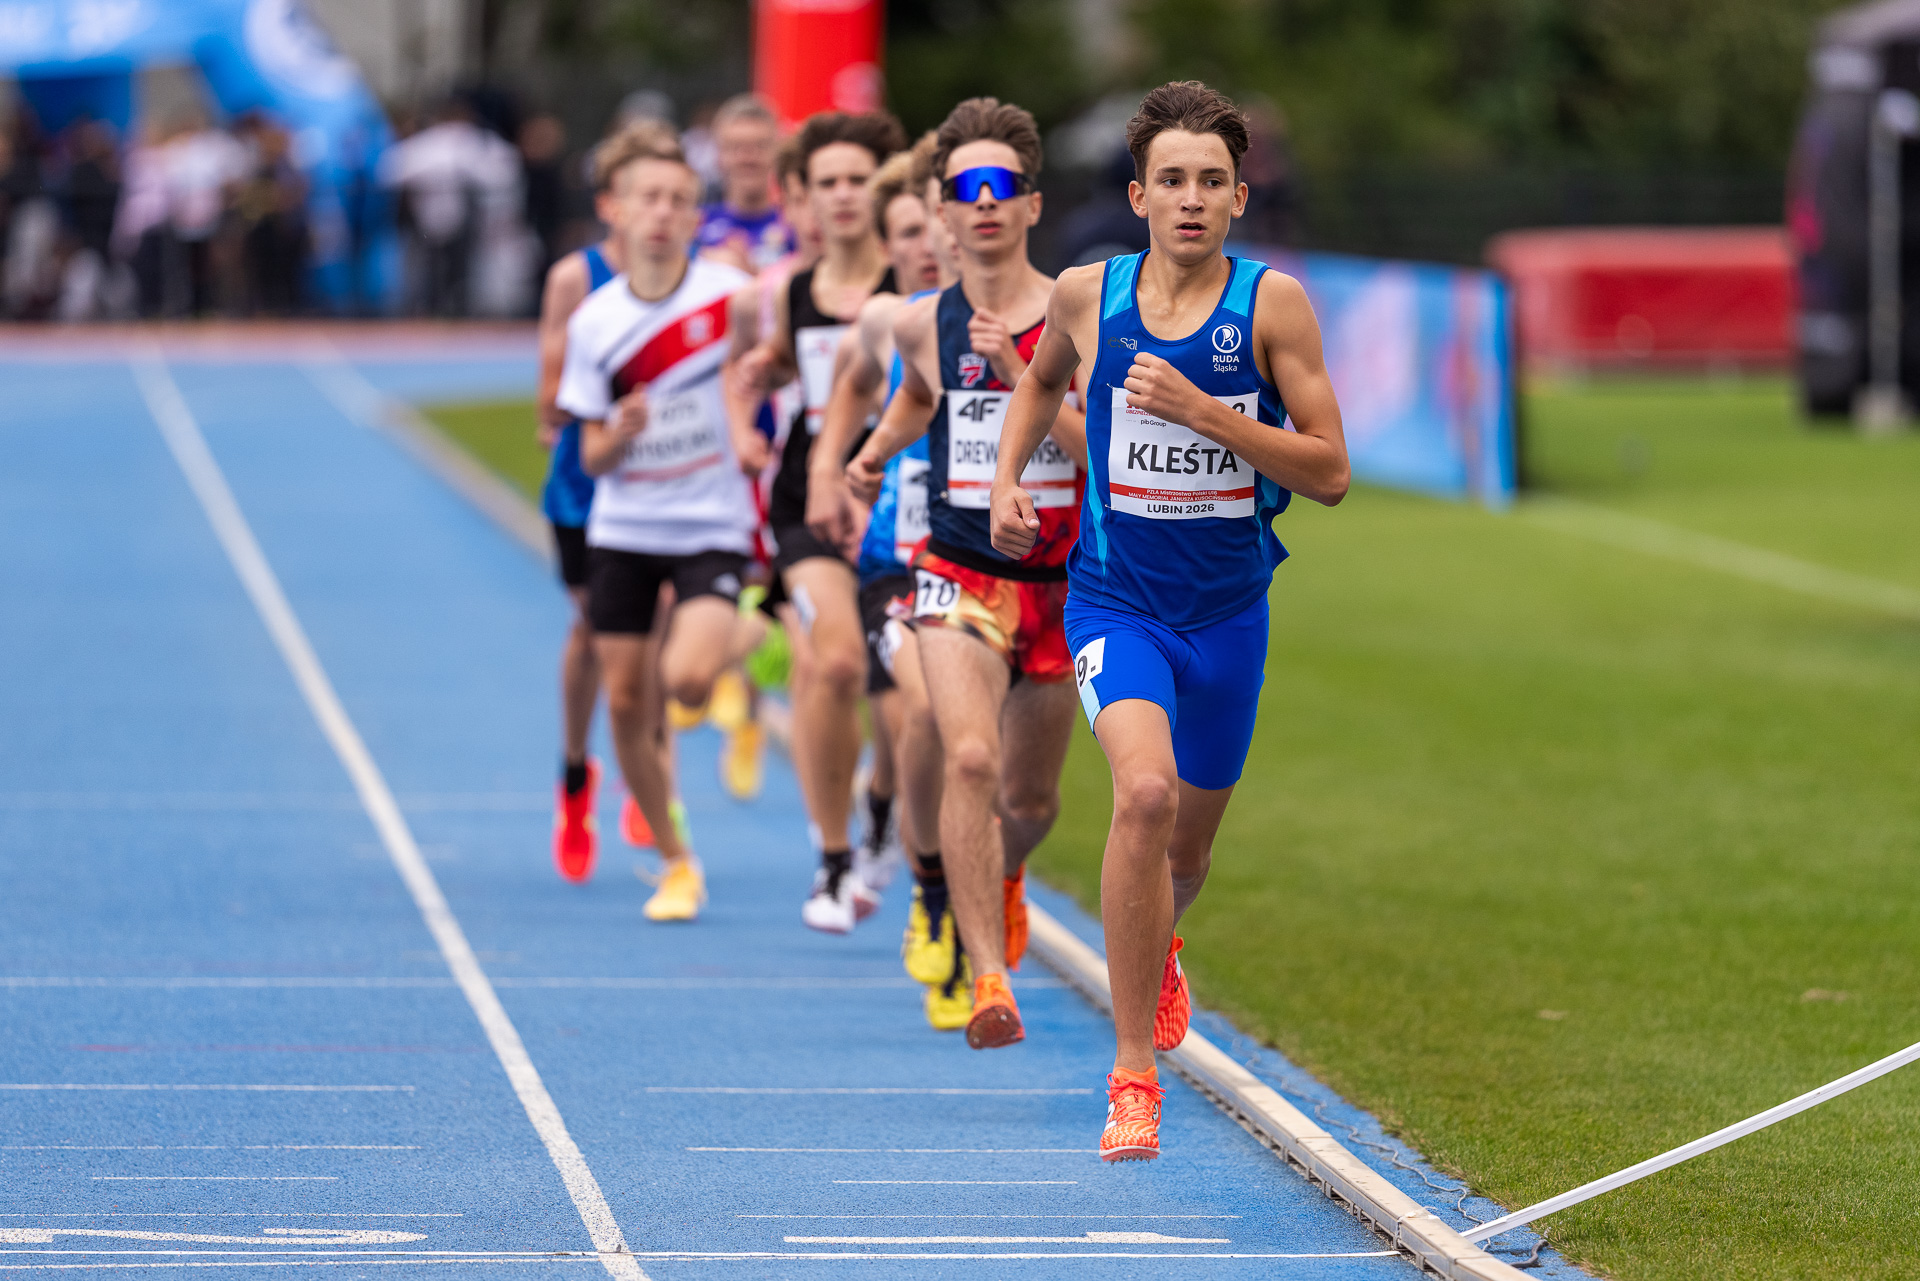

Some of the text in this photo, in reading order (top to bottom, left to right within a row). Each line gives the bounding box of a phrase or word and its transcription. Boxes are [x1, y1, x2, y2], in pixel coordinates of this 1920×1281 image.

[1212, 355, 1240, 363] RUDA
[1213, 362, 1238, 374] Śląska
[958, 397, 1001, 422] 4F
[1127, 442, 1239, 475] KLEŚTA
[1147, 503, 1215, 514] LUBIN 2026
[922, 580, 955, 607] 10
